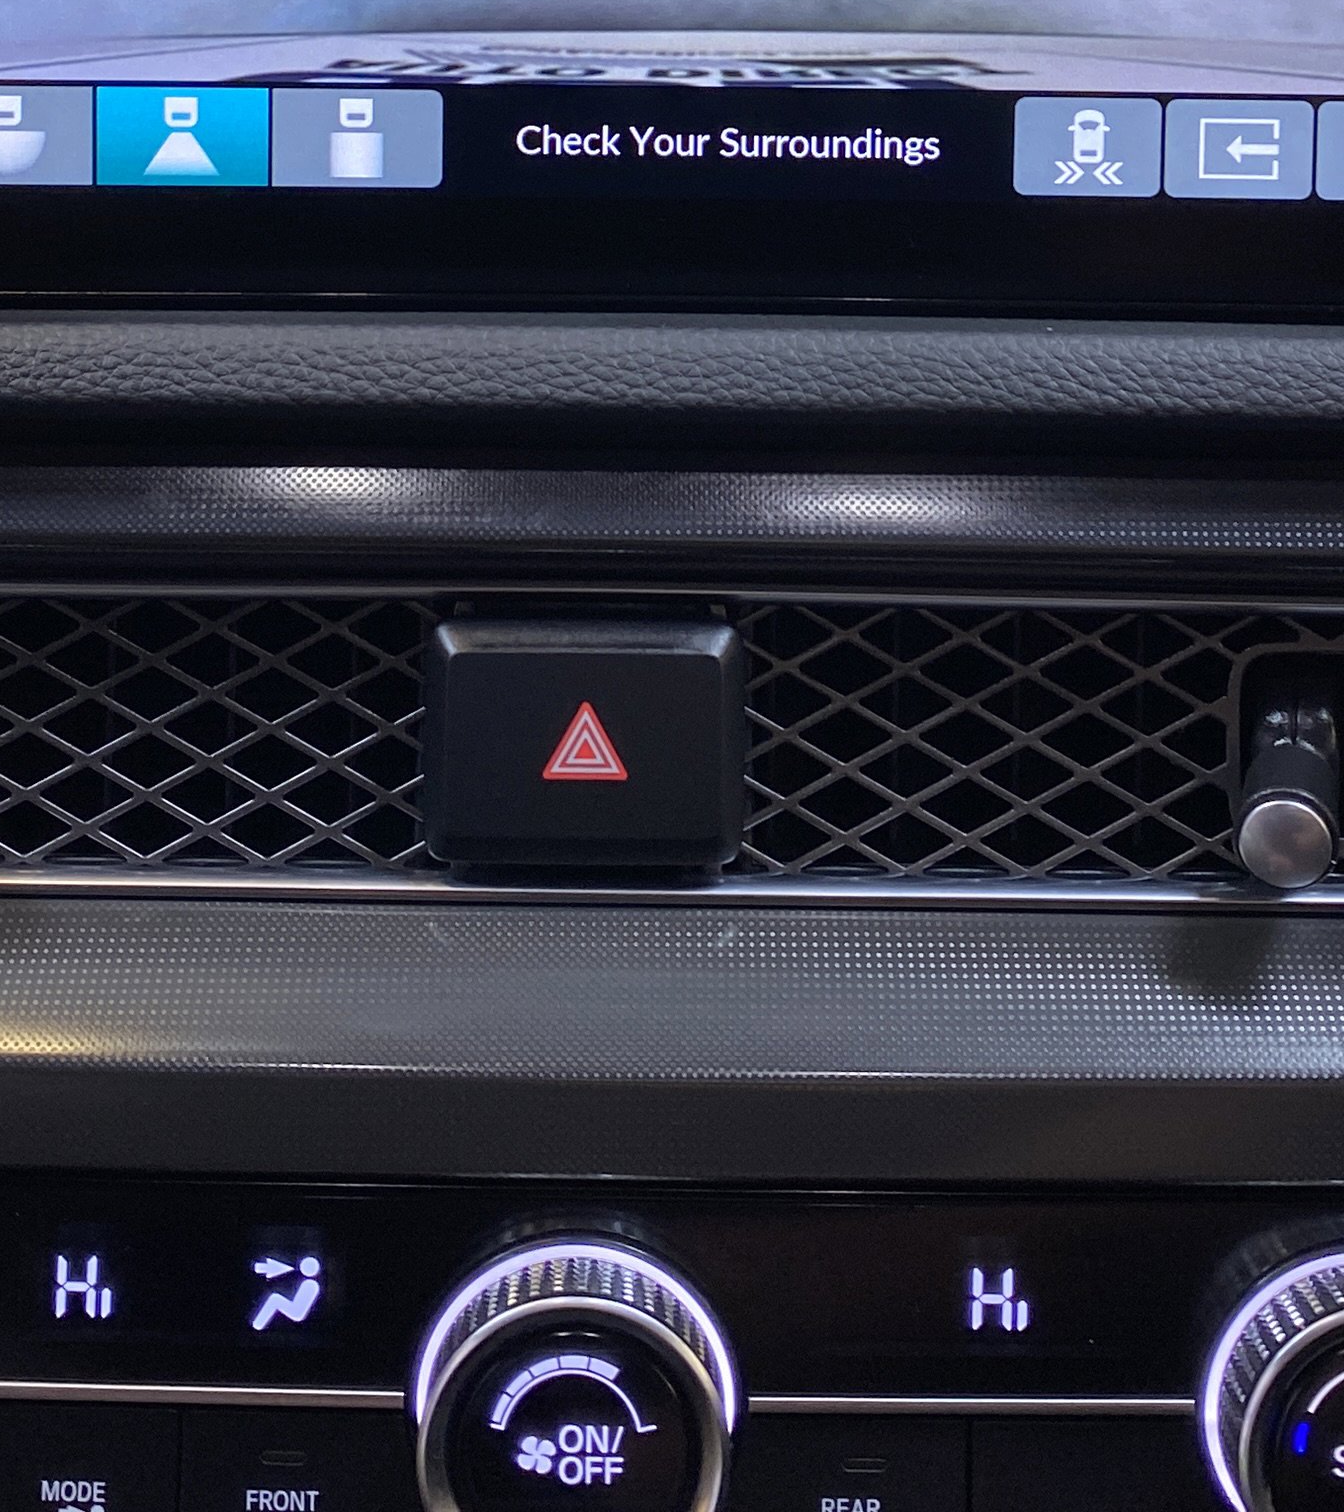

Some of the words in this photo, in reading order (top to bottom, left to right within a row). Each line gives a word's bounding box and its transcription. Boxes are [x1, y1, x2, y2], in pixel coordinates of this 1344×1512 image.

[516, 124, 621, 156] Check
[628, 126, 711, 157] Your
[719, 127, 941, 166] Surroundings
[558, 1424, 624, 1454] ON/
[558, 1455, 625, 1485] OFF
[41, 1480, 106, 1503] MODE
[246, 1489, 320, 1512] FRONT
[821, 1497, 881, 1512] REAR
